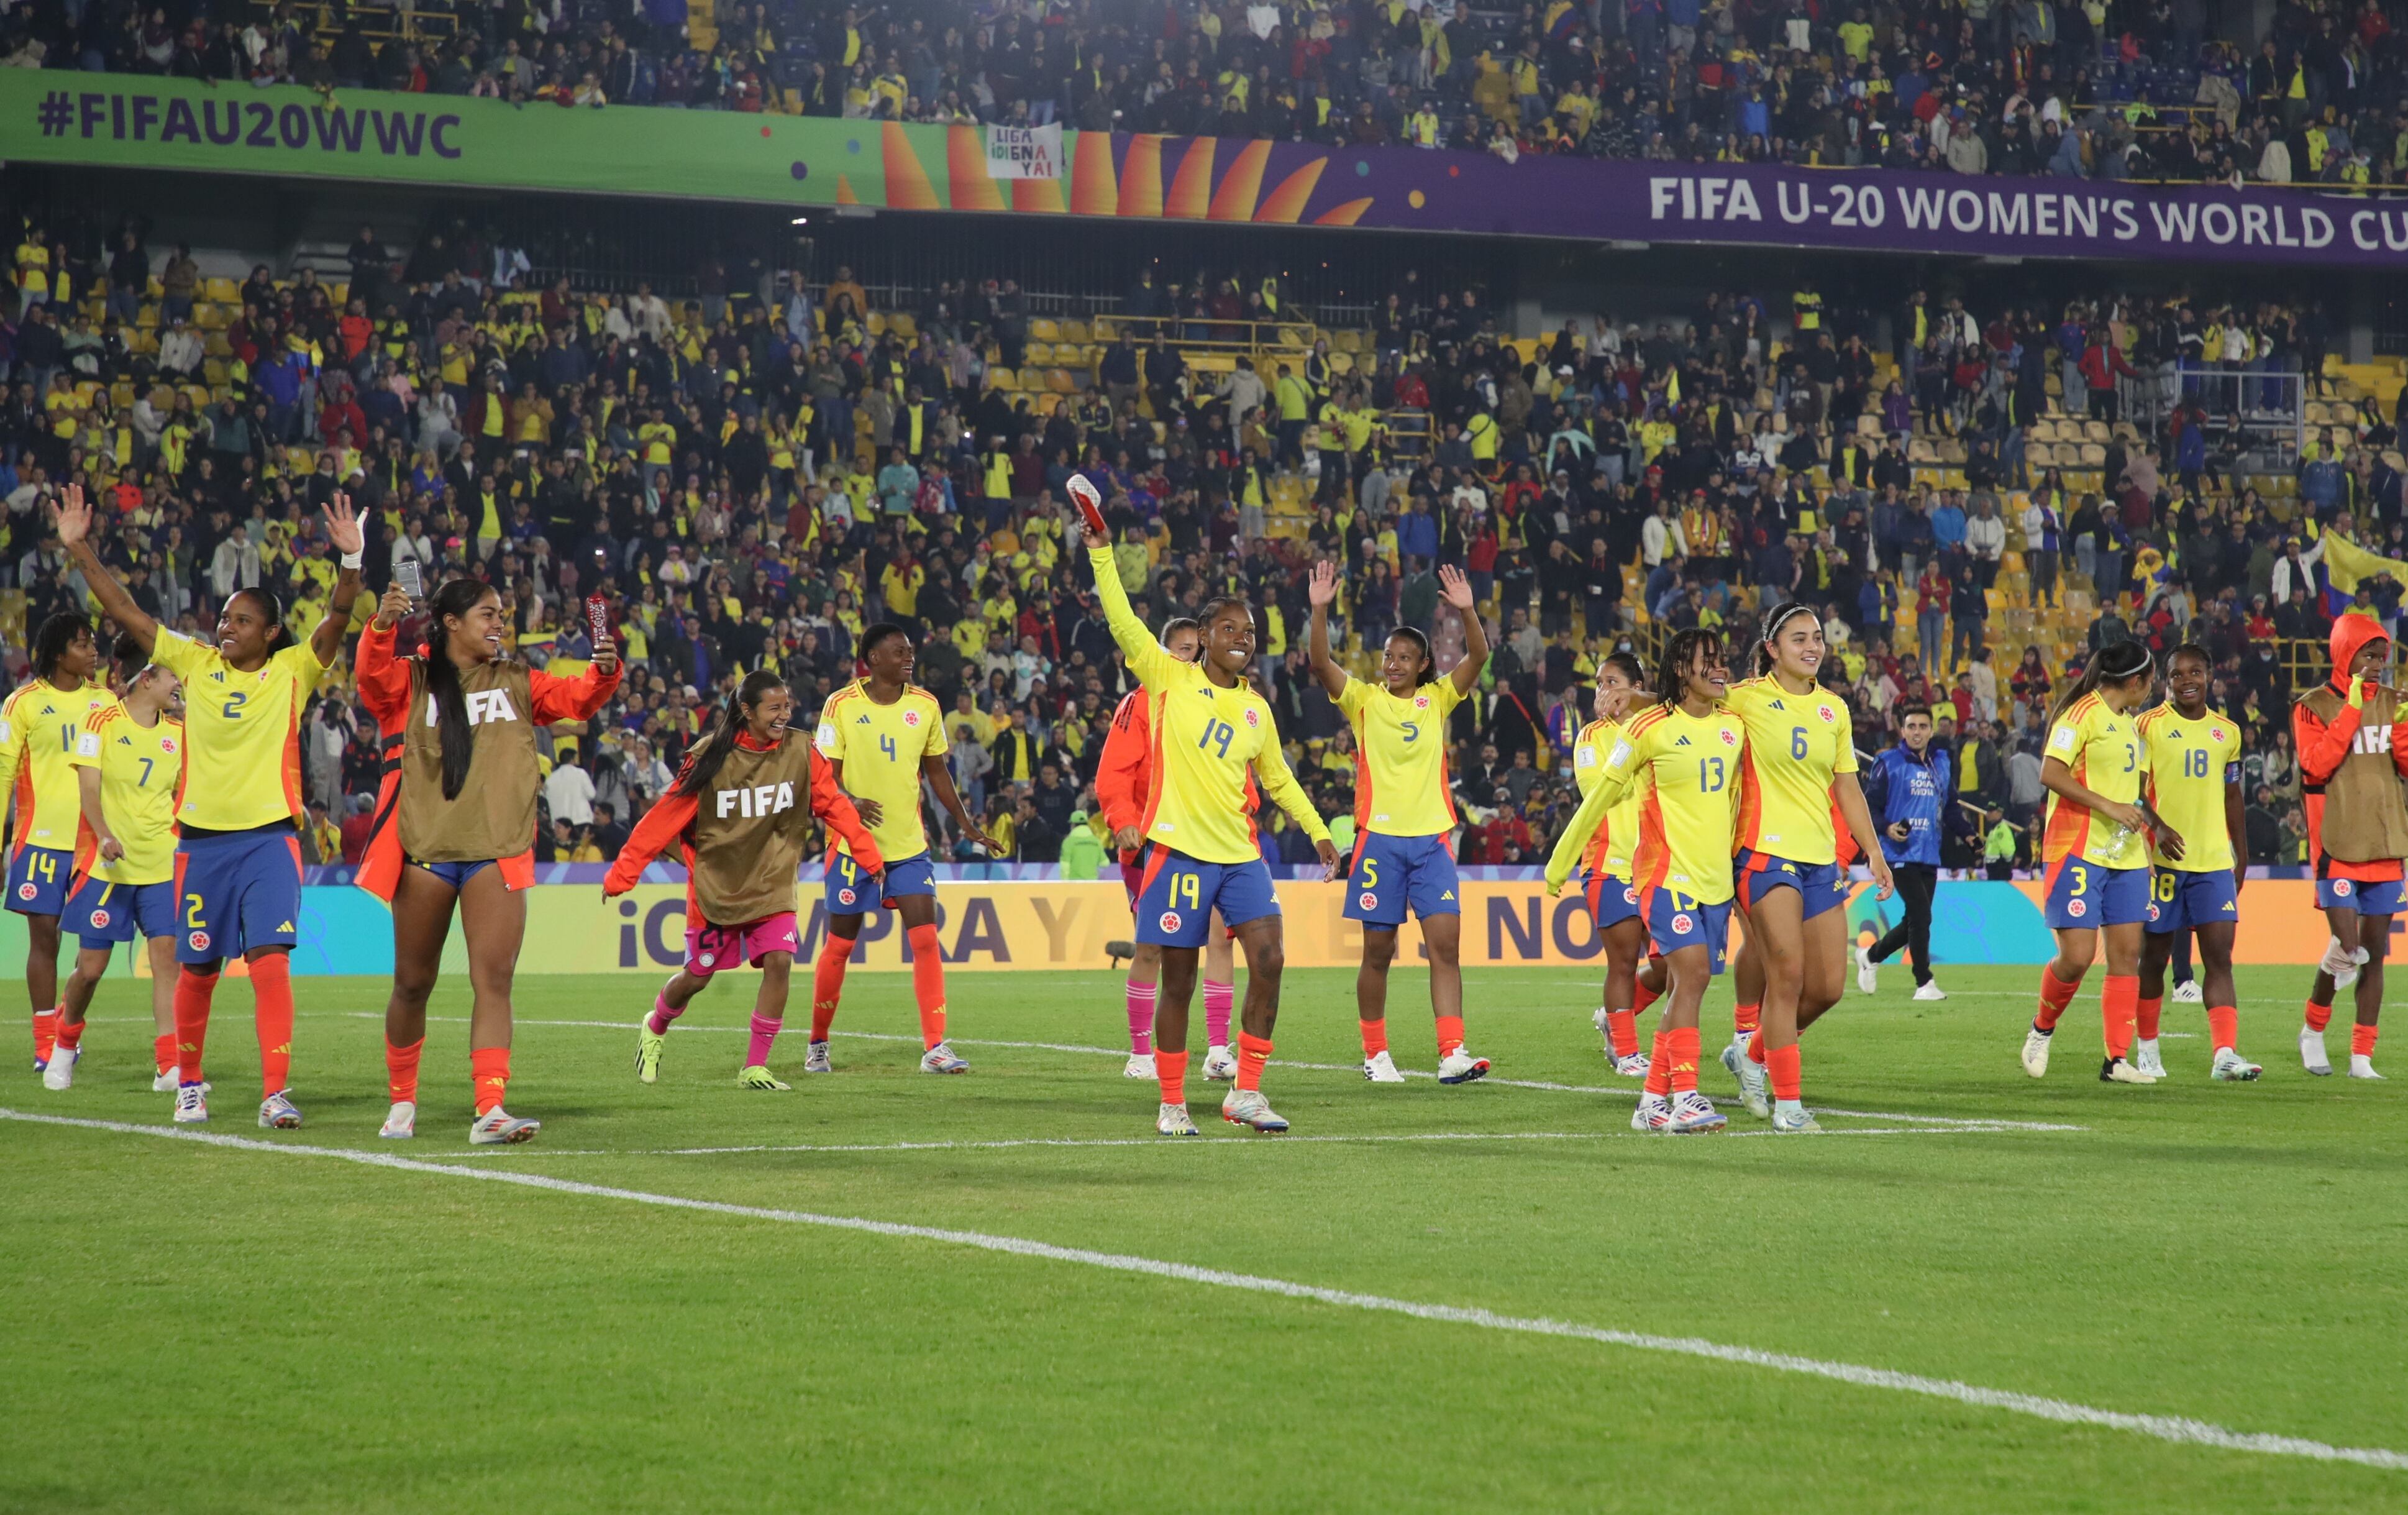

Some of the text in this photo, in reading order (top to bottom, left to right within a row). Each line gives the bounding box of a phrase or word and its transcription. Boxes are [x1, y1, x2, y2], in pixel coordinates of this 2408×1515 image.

[38, 91, 462, 159] #FIFAU20WWC
[996, 129, 1033, 143] LIGA
[1022, 162, 1052, 177] YA!
[1649, 177, 1762, 221] FIFA
[1777, 181, 1885, 227] U-20
[2149, 201, 2335, 249] WORLD
[223, 692, 247, 718] 2
[426, 688, 517, 727] FA
[1198, 718, 1234, 759] 19
[1400, 721, 1418, 742] 5
[1791, 726, 1808, 761] 6
[2353, 725, 2392, 754] IFA
[880, 733, 896, 762] 4
[2123, 743, 2135, 772] 3
[138, 757, 153, 787] 7
[1700, 757, 1725, 793] 13
[2184, 749, 2209, 778] 18
[716, 780, 794, 818] FIFA
[27, 851, 56, 884] 14
[841, 857, 856, 886] 4
[1362, 858, 1378, 889] 5
[2070, 866, 2087, 896] 3
[1169, 872, 1200, 910] 19
[2150, 873, 2176, 902] 18
[186, 894, 207, 928] 2
[1487, 896, 1646, 960] NO
